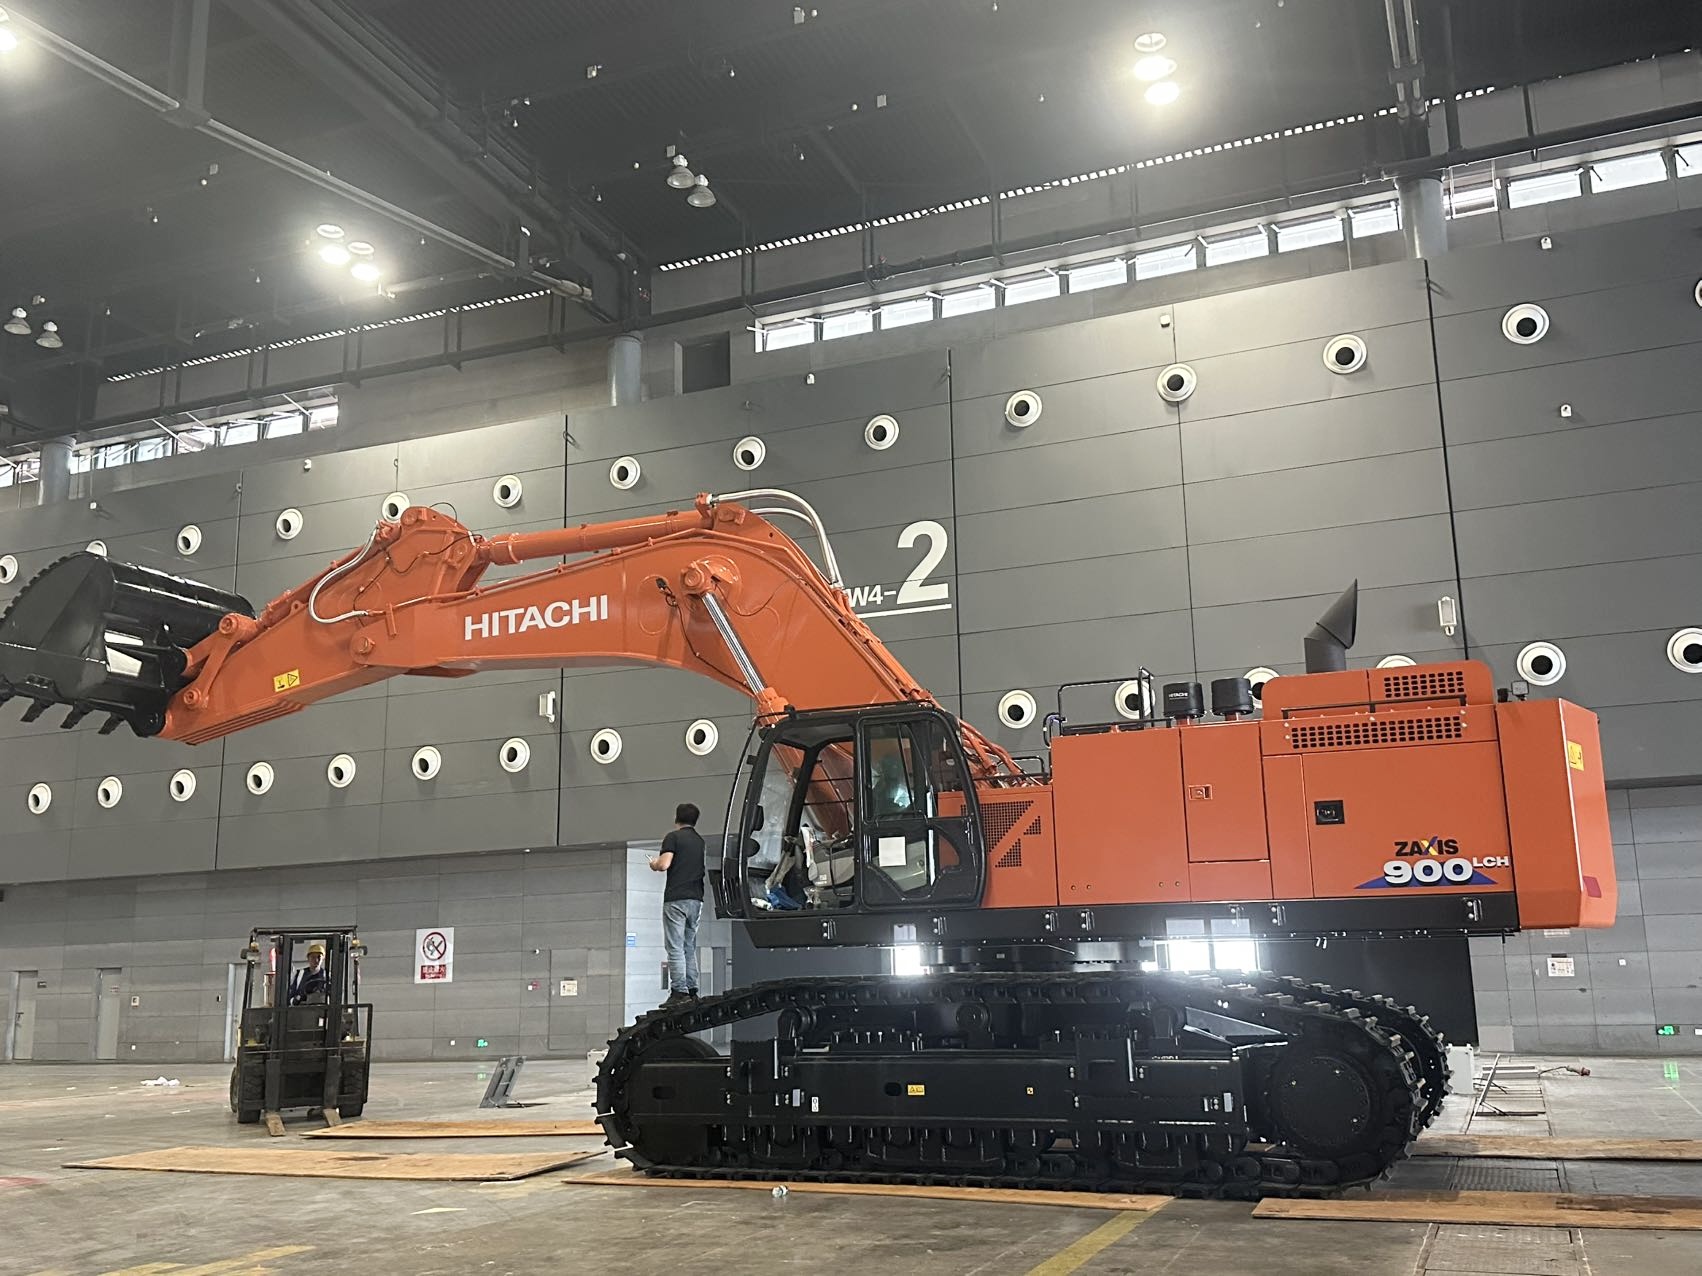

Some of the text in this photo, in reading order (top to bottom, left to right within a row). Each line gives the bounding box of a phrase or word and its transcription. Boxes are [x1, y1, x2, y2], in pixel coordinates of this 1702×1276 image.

[464, 594, 608, 641] HITACHI
[1394, 836, 1459, 857] ZAXIS
[1383, 855, 1510, 887] 900 LCH
